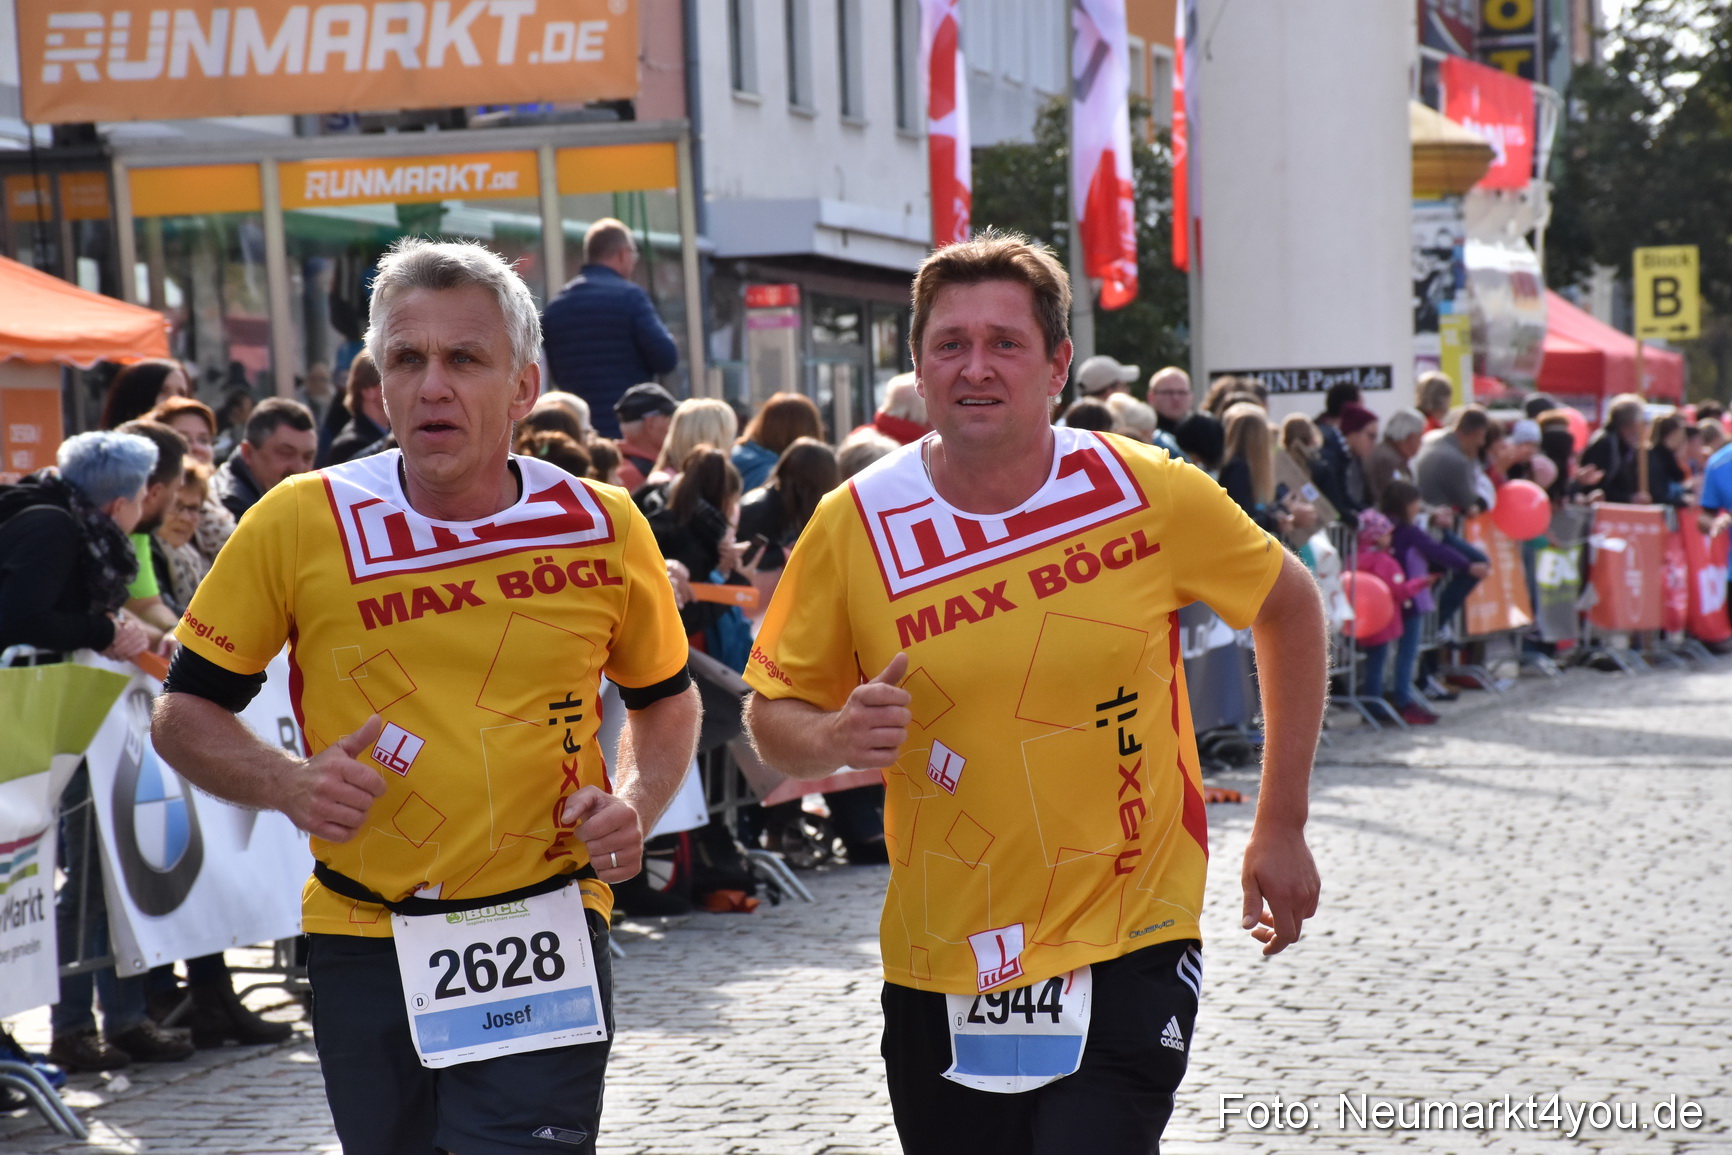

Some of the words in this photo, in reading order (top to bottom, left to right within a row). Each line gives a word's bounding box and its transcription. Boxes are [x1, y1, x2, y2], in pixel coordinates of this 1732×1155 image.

[41, 0, 608, 83] RUNMARKT.DE
[305, 163, 518, 199] RUNMARKT.DE
[1652, 275, 1682, 317] B
[356, 579, 487, 631] MAX
[496, 555, 623, 599] BÖGL
[895, 579, 1018, 650] MAX
[1027, 529, 1161, 600] BÖGL
[0, 887, 45, 932] Markt
[465, 900, 528, 920] BOCK
[428, 931, 566, 1000] 2628
[416, 997, 424, 1007] D
[482, 1004, 532, 1030] Josef
[967, 976, 1064, 1025] 2944
[1160, 1037, 1185, 1052] adidas
